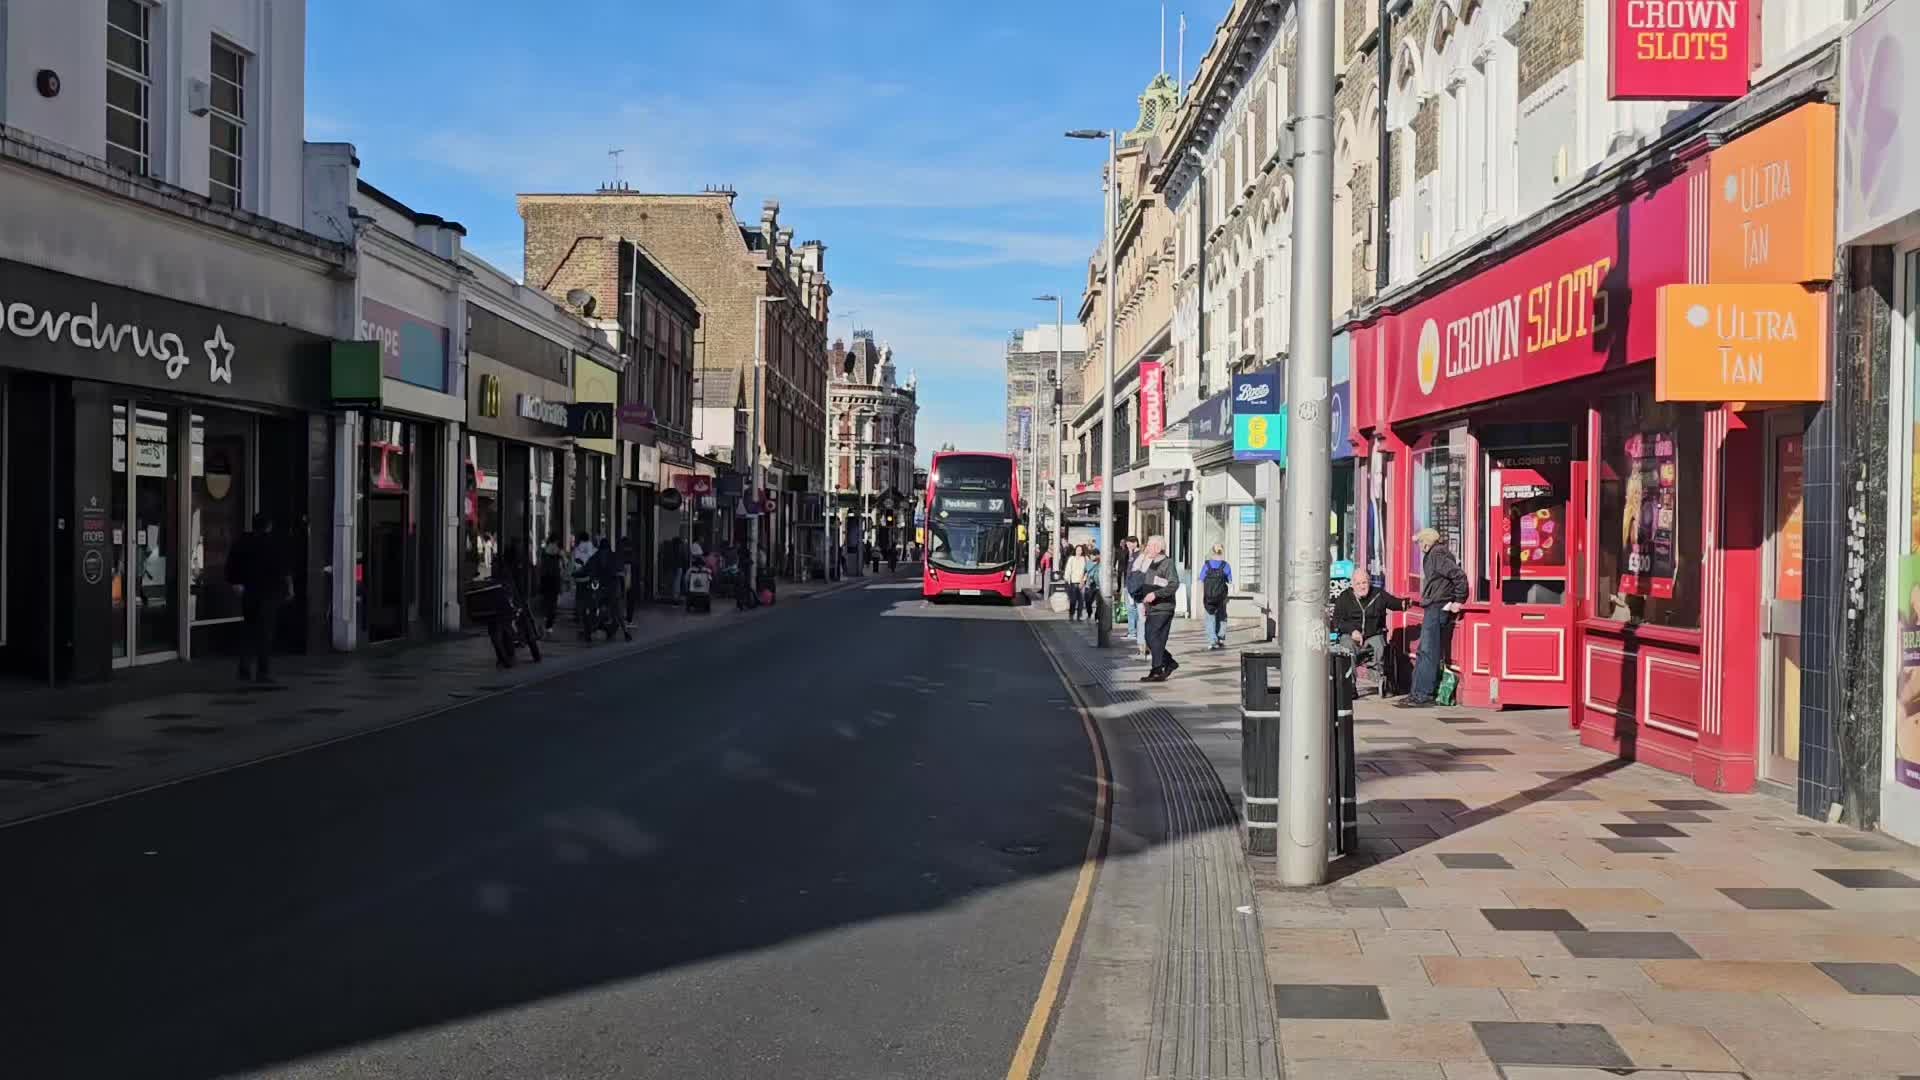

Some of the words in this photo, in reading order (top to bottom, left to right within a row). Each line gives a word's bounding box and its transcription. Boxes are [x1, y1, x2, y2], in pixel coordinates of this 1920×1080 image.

[1627, 0, 1737, 28] CROWN
[1637, 32, 1728, 60] SLOTS
[1741, 160, 1792, 214] ULTRA
[1742, 219, 1769, 270] TAN
[1445, 294, 1522, 379] CROWN
[1527, 256, 1610, 353] SLOTS
[1716, 304, 1798, 342] ULTRA
[0, 300, 190, 380] erdrug
[1719, 345, 1764, 385] TAN
[1236, 383, 1270, 402] Boots
[1498, 457, 1545, 467] WELCOME
[1549, 455, 1561, 465] TO
[945, 499, 977, 511] Peckham
[988, 499, 1004, 511] 37
